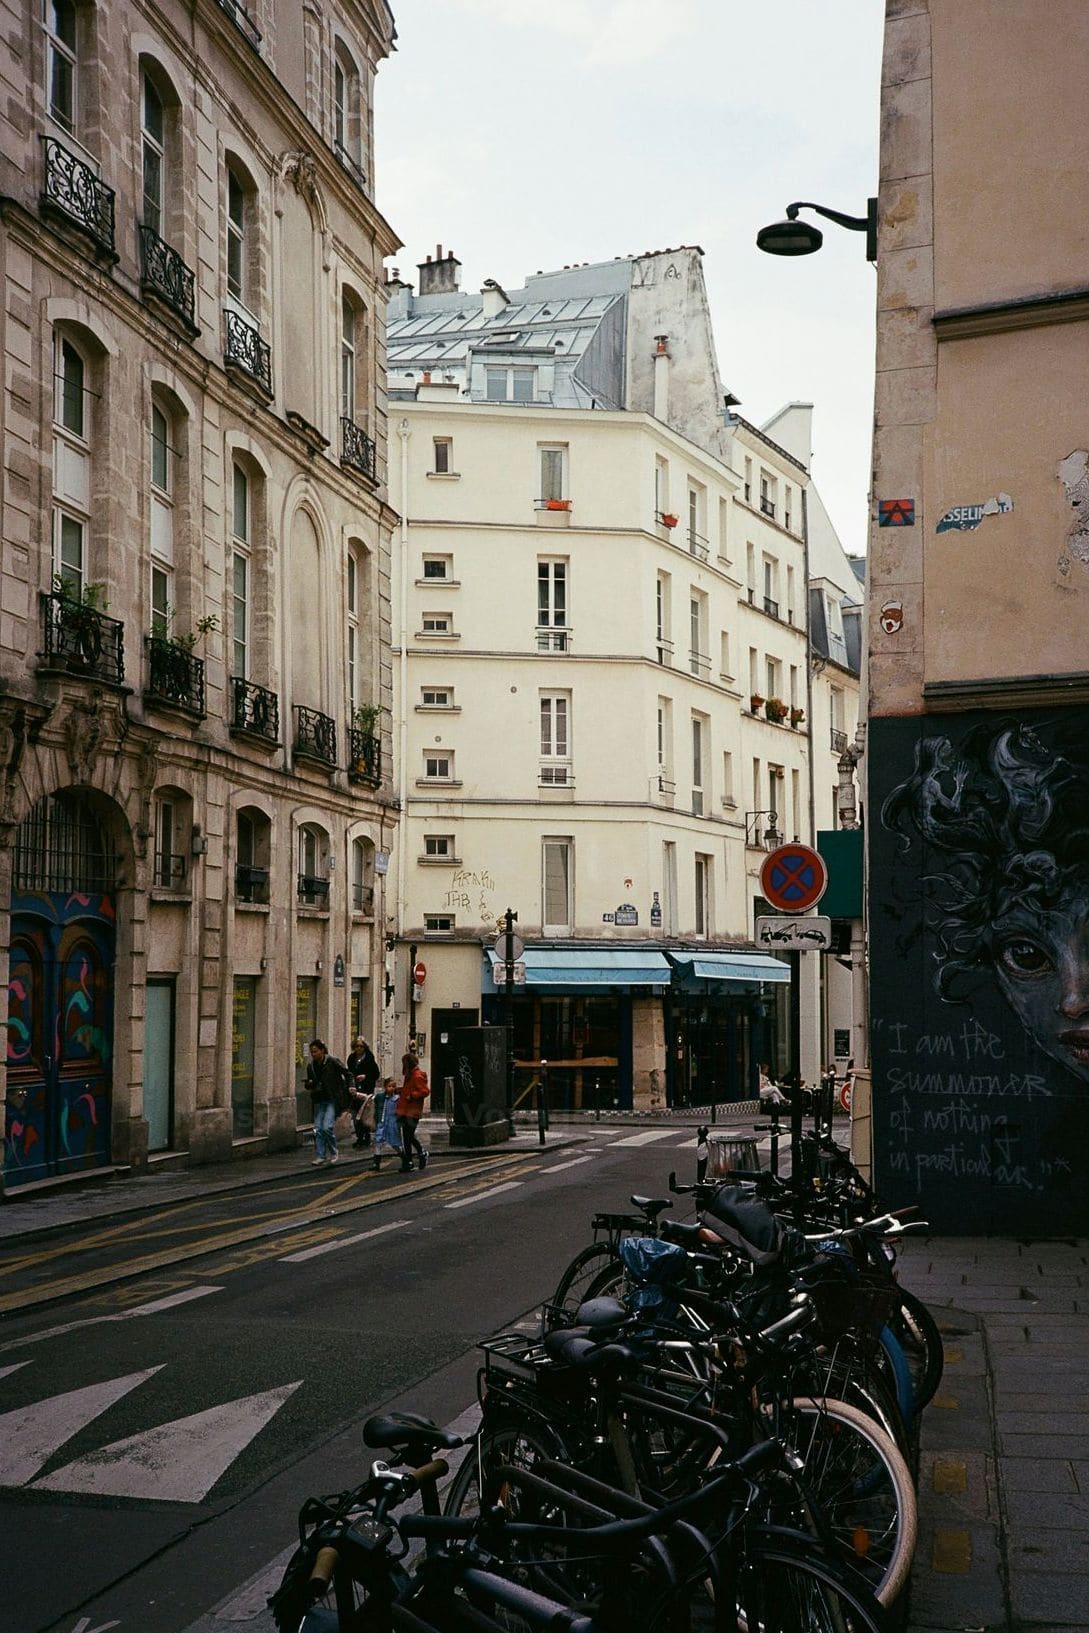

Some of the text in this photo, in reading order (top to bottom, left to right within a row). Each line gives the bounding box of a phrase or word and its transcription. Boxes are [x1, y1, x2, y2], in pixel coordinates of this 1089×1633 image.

[915, 1035, 955, 1057] am
[960, 1020, 1006, 1060] the
[889, 1095, 915, 1143] of
[888, 1140, 911, 1172] in
